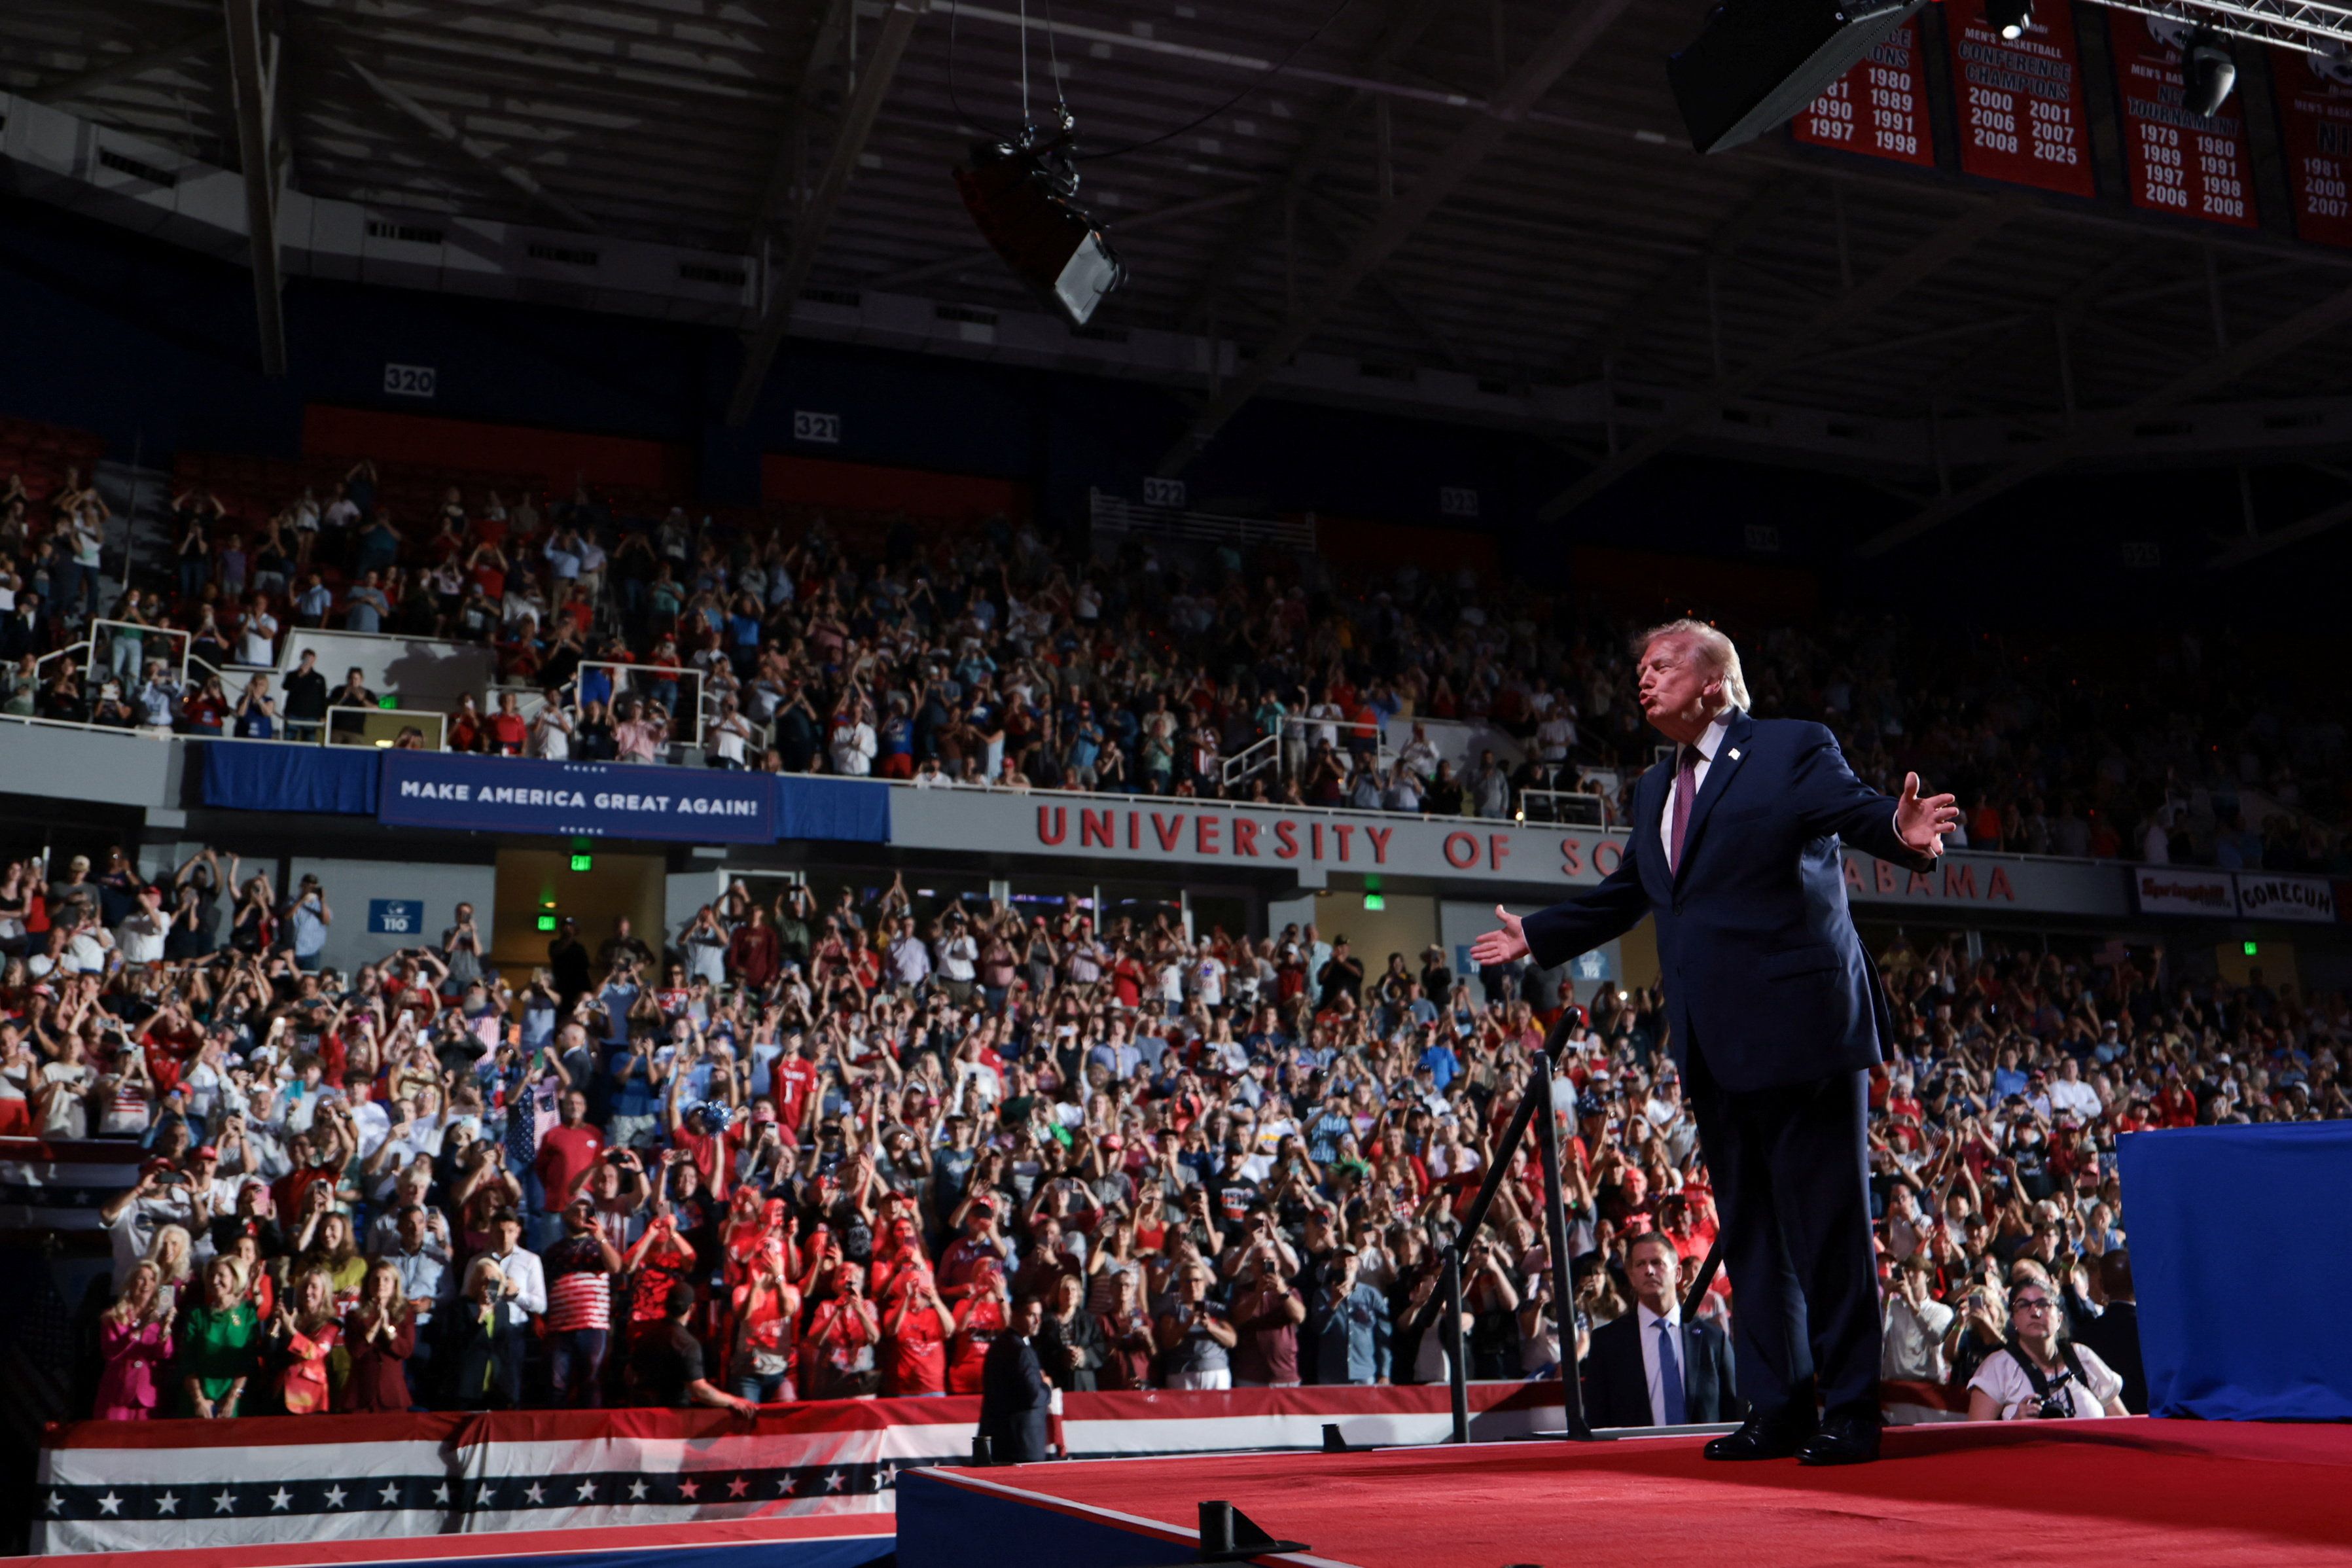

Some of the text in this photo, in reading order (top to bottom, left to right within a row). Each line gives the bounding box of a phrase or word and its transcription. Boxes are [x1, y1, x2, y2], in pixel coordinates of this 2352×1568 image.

[1959, 40, 2071, 82] CONFERENCE
[1868, 67, 1911, 92] 1980
[1966, 63, 2069, 102] CHAMPIONS
[1809, 97, 1914, 133] 1990 1991
[1870, 88, 1913, 113] 1989
[1969, 86, 2071, 124] 2000 2001
[1809, 118, 1917, 155] 1997 1998
[1970, 107, 2074, 145] 2006 2007
[2140, 123, 2235, 158] 1979 1980
[1974, 128, 2077, 165] 2008 2025
[2143, 144, 2236, 177] 1989 1991
[2146, 164, 2241, 198] 1997 1998
[2304, 157, 2341, 178] 1981
[2146, 183, 2244, 218] 2006 2008
[2305, 175, 2346, 196] 2000
[2307, 195, 2348, 217] 2007
[387, 367, 433, 392] 320
[796, 415, 838, 438] 321
[1145, 481, 1184, 504] 322
[401, 781, 758, 817] MAKE AMERICA GREAT AGAIN!
[1038, 806, 1393, 863] UNIVERSITY
[1444, 831, 1511, 870] OF
[1844, 857, 2015, 900] ABAMA
[383, 918, 409, 932] 110
